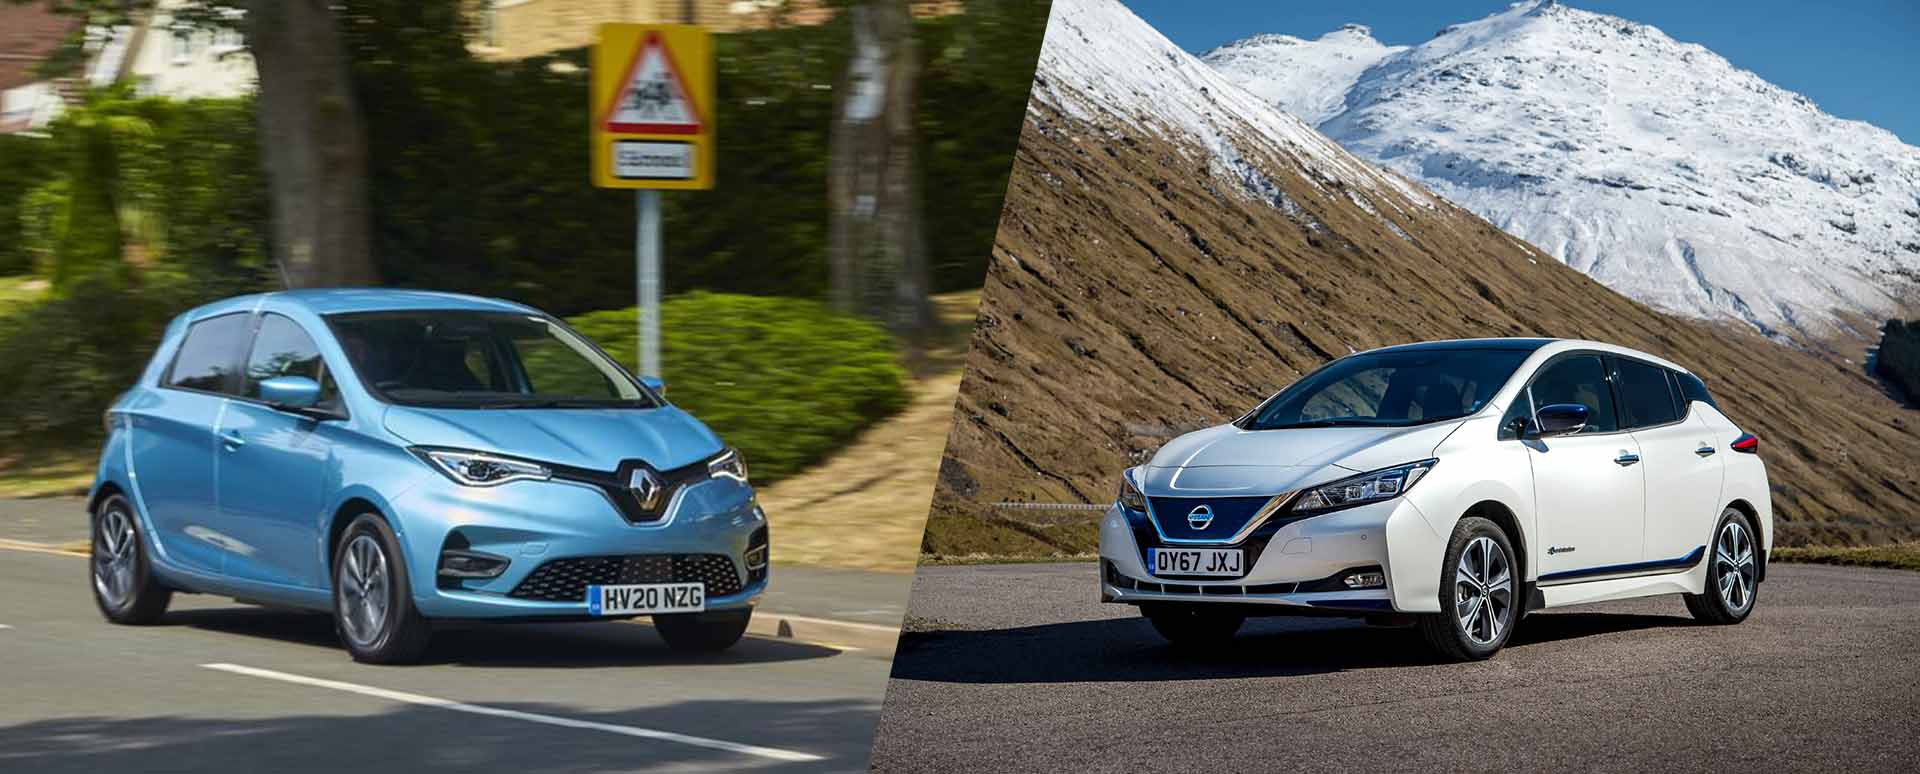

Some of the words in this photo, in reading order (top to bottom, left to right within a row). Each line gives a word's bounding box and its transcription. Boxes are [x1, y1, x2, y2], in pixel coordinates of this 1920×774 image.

[1158, 552, 1201, 571] OY67
[1206, 552, 1240, 572] JXJ
[605, 588, 658, 610] HV20
[664, 586, 701, 608] NZG
